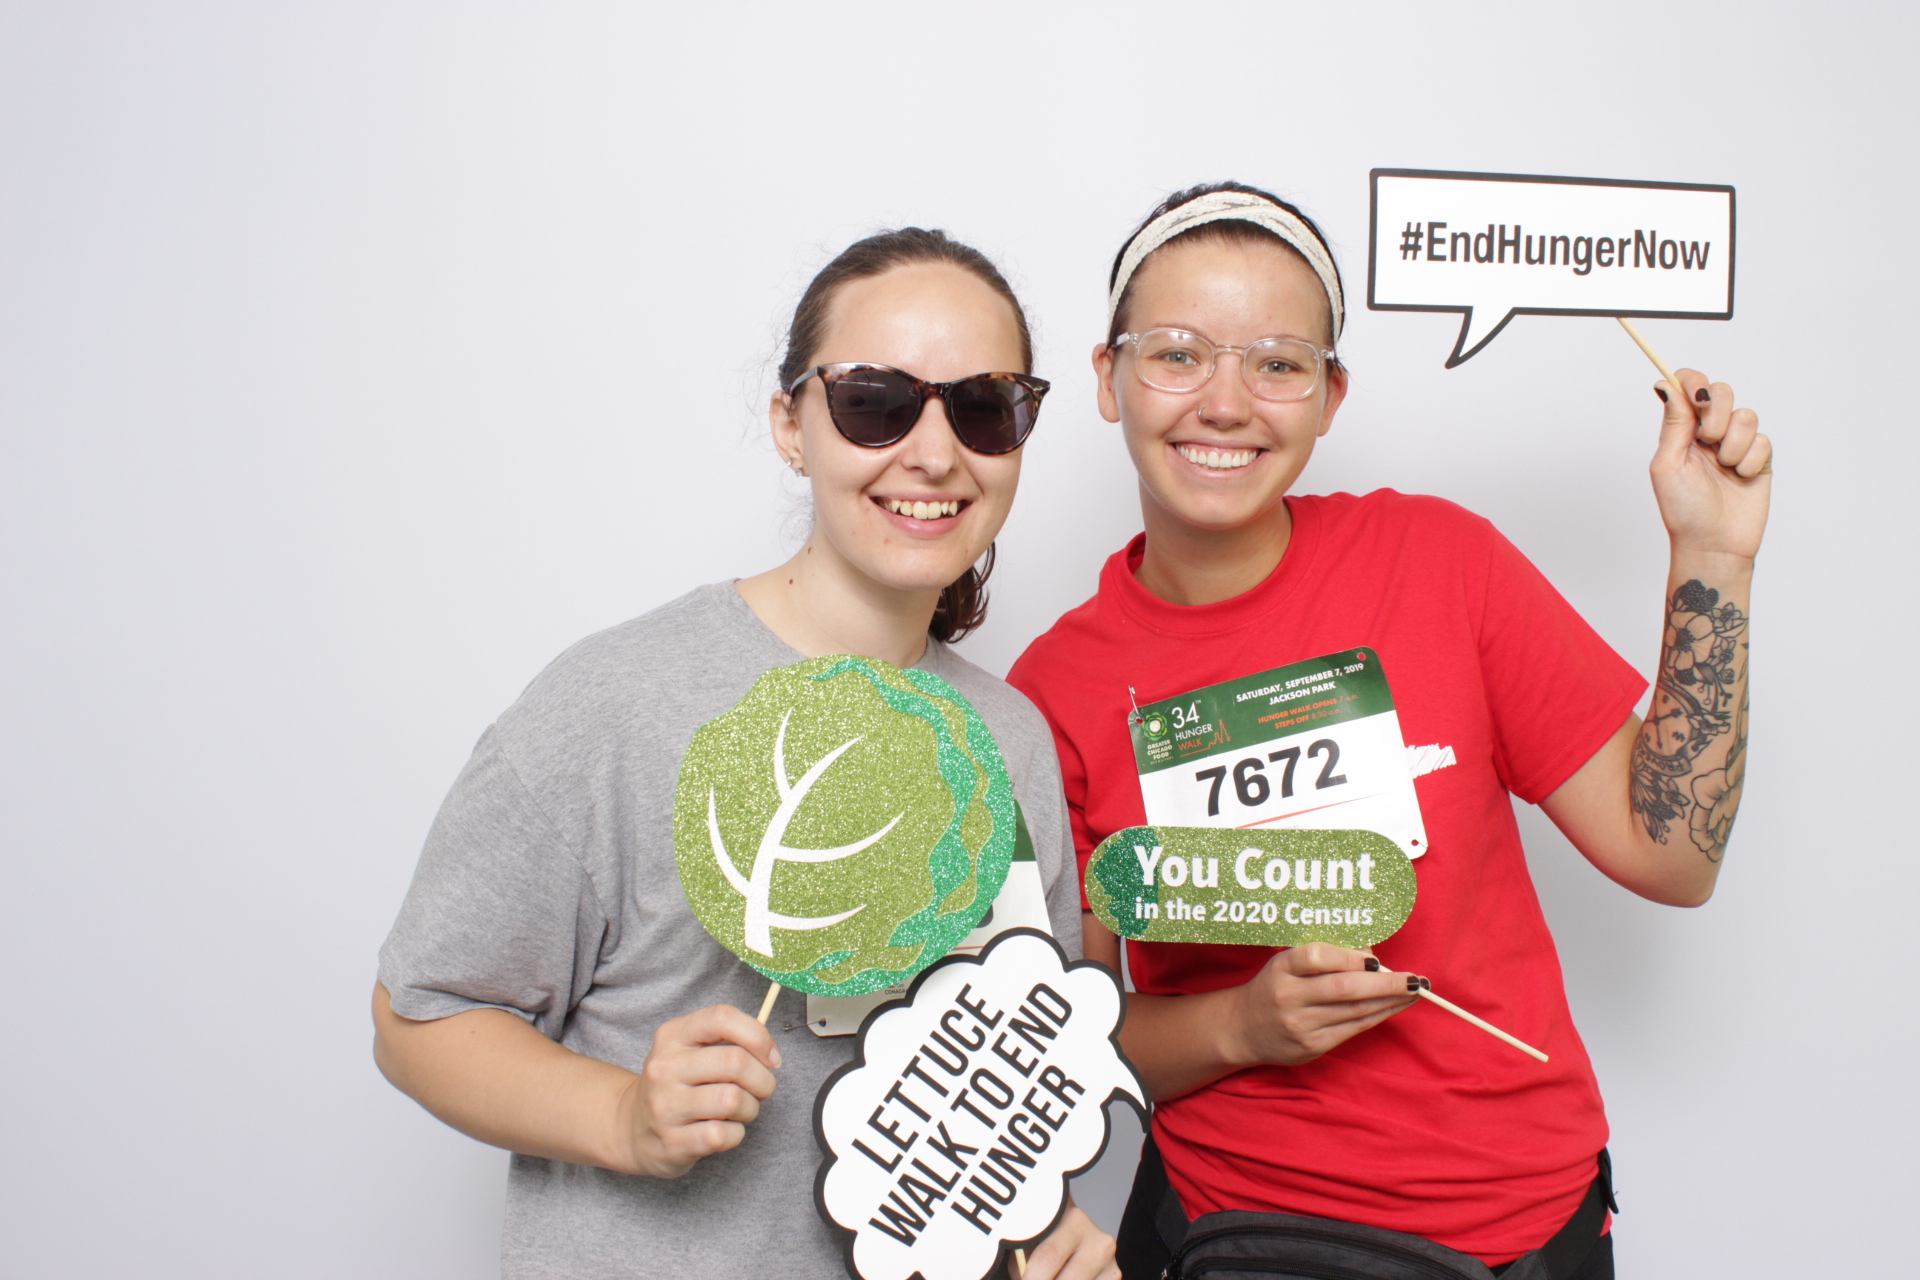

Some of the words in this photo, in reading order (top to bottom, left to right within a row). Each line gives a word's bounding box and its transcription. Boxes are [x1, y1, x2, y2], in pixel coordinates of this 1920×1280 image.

[1399, 221, 1711, 276] #EndHungerNow
[1236, 684, 1283, 702] SATURDAY,
[1285, 670, 1334, 689] SEPTEMBER
[1334, 668, 1342, 677] 7,
[1343, 663, 1364, 674] 2019
[1269, 688, 1311, 705] JACKSON
[1312, 681, 1336, 693] PARK
[1258, 709, 1289, 723] HUNGER
[1289, 705, 1311, 715] WALK
[1313, 698, 1338, 709] OPENS
[1275, 719, 1295, 729] STEPS
[1295, 715, 1310, 724] OFF
[1147, 739, 1171, 750] GREATER
[1175, 723, 1213, 741] HUNGER
[1177, 738, 1203, 751] WALK
[1147, 745, 1173, 756] CHICAGO
[1153, 752, 1170, 760] FOOD
[1195, 738, 1348, 817] 7672
[1133, 845, 1218, 888] You
[1234, 848, 1376, 891] Count
[1135, 896, 1159, 920] in
[1165, 898, 1207, 922] the
[1213, 900, 1278, 923] 2020
[1284, 902, 1373, 926] Census
[851, 983, 1005, 1175] LETTUCE
[868, 1120, 979, 1248] WALK
[949, 1067, 1015, 1131] TO
[991, 983, 1073, 1079] END
[950, 1064, 1086, 1236] HUNGER
